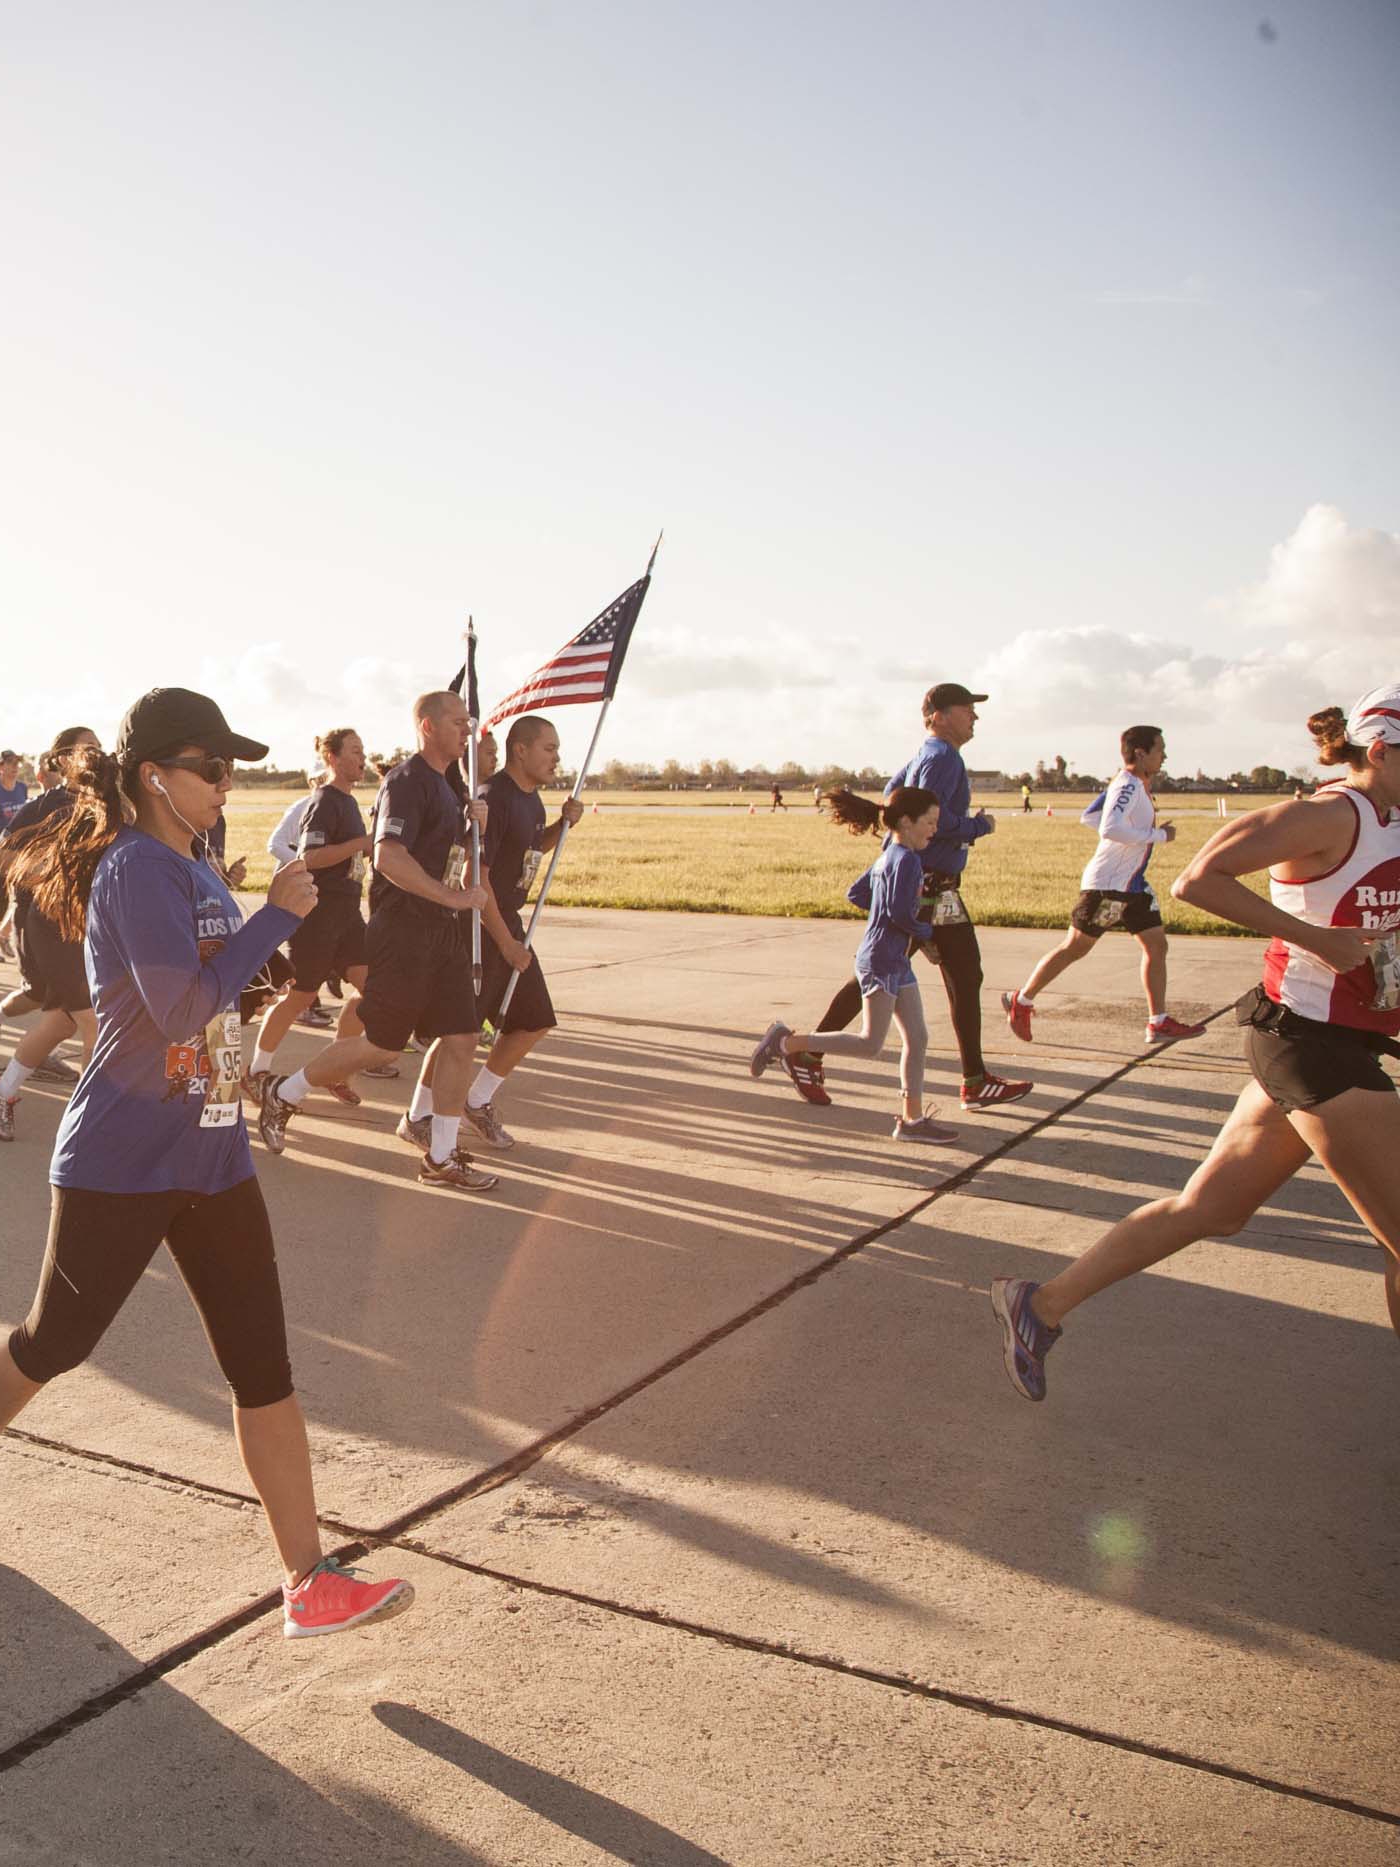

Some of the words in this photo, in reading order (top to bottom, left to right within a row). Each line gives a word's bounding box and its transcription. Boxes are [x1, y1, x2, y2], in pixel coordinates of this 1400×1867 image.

[1113, 783, 1136, 814] 2015
[1355, 886, 1400, 907] Ru
[197, 917, 228, 938] LOS
